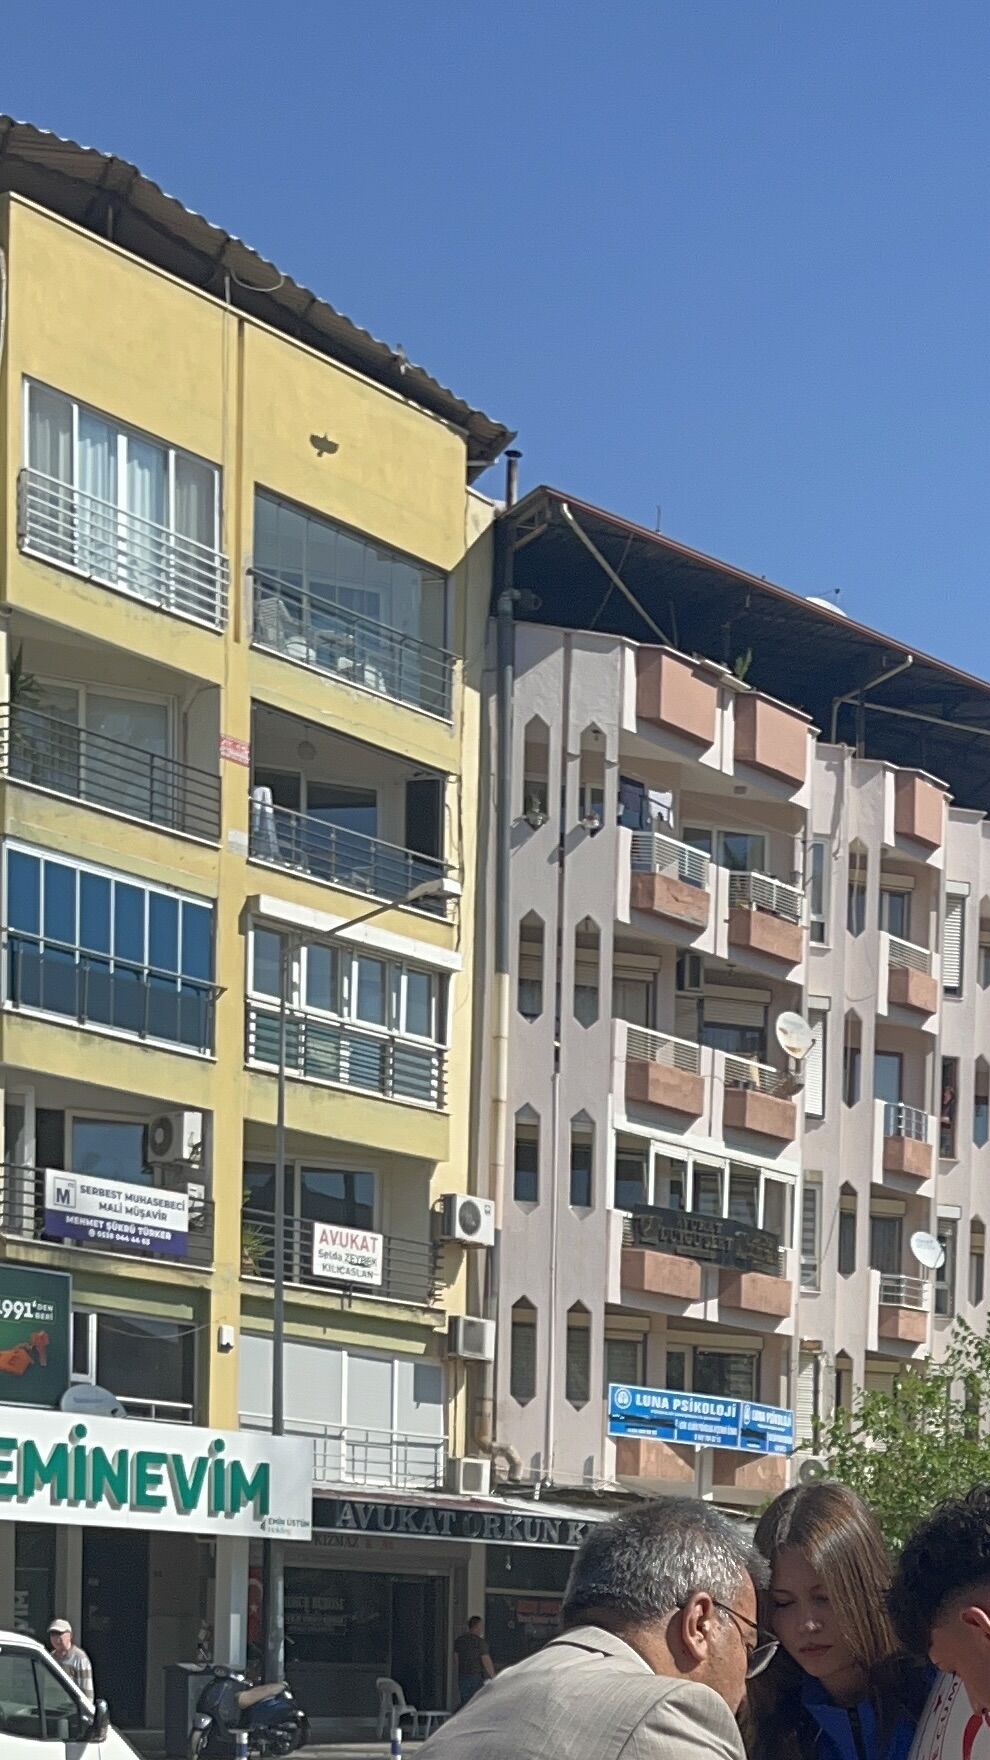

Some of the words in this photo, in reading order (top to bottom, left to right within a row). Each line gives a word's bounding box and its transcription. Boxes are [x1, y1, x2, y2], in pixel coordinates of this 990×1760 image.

[80, 1185, 122, 1200] SERBEST
[99, 1202, 122, 1214] MALİ
[319, 1228, 379, 1253] AVUKAT
[636, 1393, 669, 1410] LUNA
[673, 1398, 737, 1418] PSİKOLOJİ
[335, 1502, 457, 1535] AVUKAT
[462, 1513, 562, 1545] ORKUN
